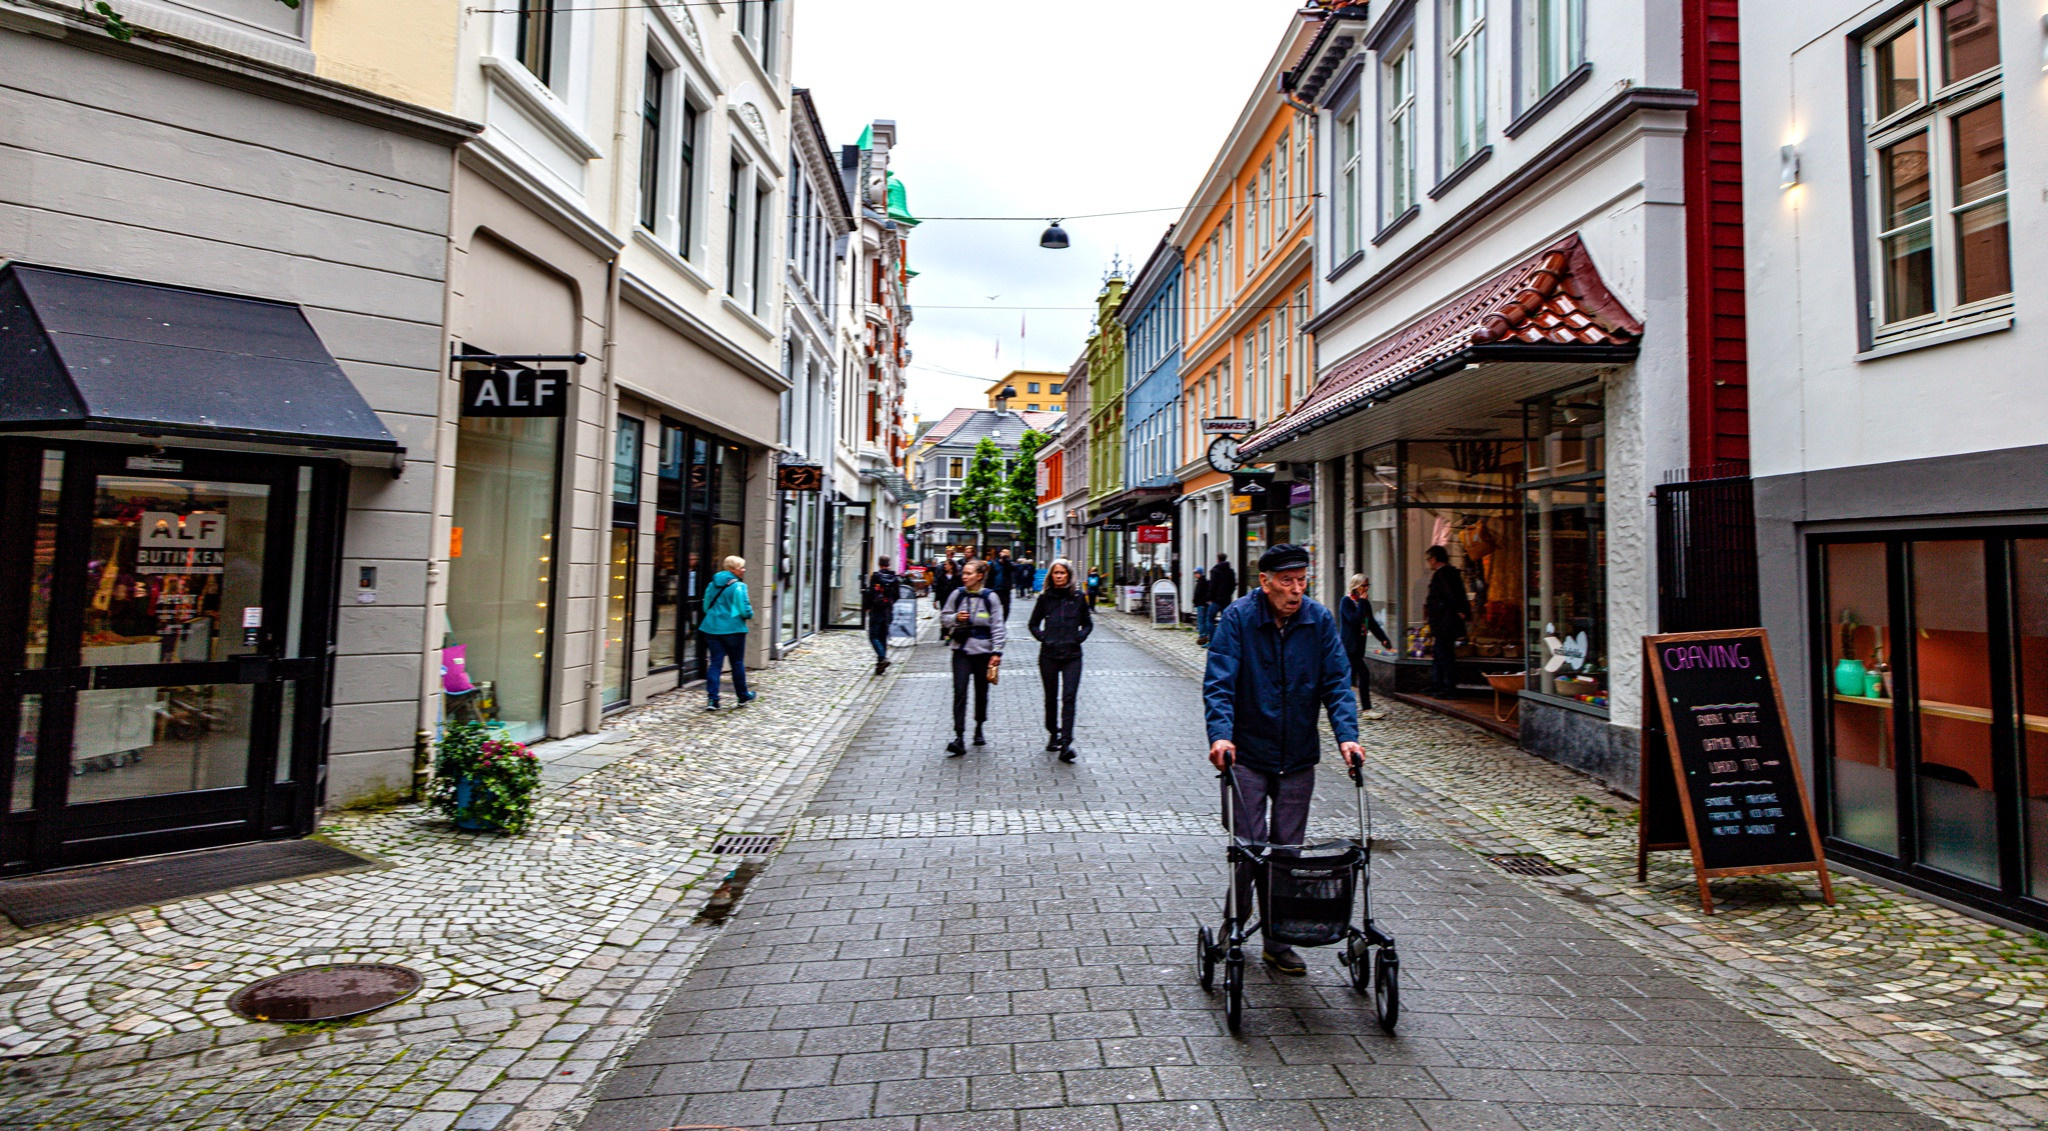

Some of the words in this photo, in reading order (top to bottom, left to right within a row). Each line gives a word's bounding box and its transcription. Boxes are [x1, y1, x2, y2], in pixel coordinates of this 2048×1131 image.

[474, 370, 556, 406] ALF
[1205, 421, 1248, 430] URMAKER
[151, 515, 218, 540] ALF
[138, 549, 224, 564] BUTIKKEN
[1664, 643, 1751, 671] CRAVING
